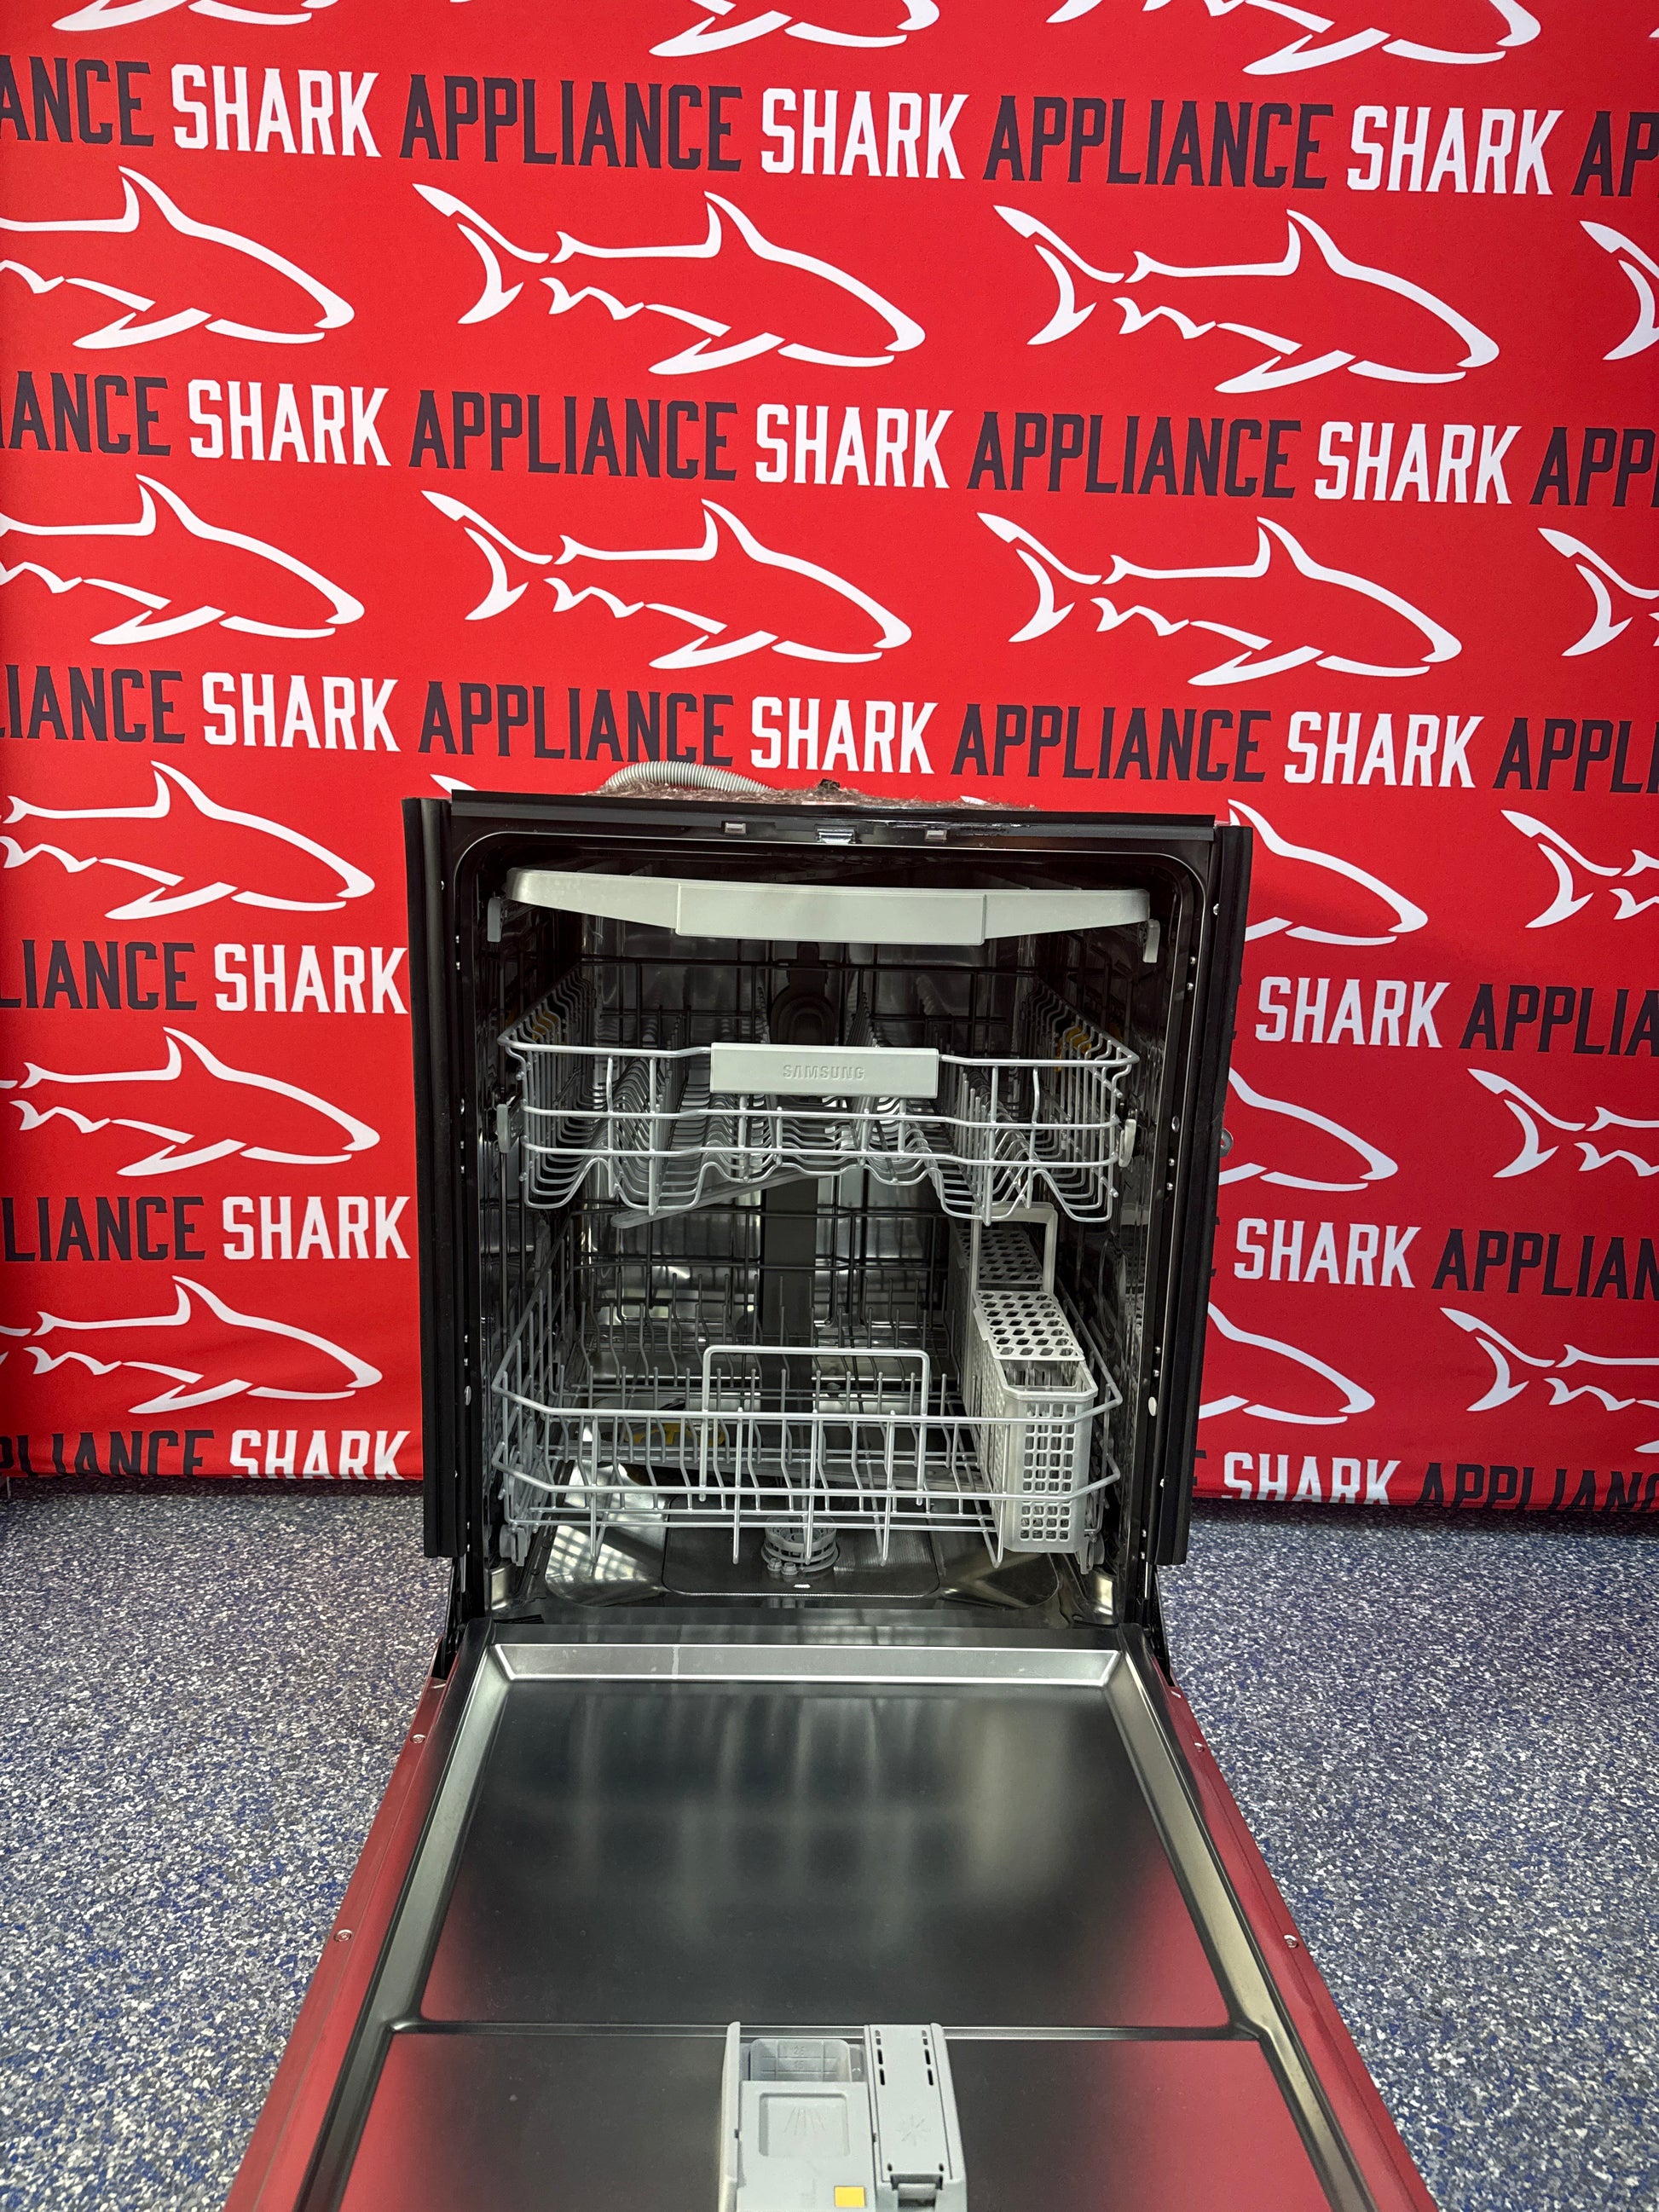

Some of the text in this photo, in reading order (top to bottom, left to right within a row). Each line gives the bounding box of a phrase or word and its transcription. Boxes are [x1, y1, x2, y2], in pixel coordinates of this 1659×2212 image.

[0, 55, 153, 147] ANCE
[171, 63, 382, 158] SHARK
[400, 74, 743, 170] APPLIANCE
[760, 87, 969, 180] SHARK
[983, 95, 1334, 189] APPLIANCE
[1346, 105, 1564, 195] SHARK
[0, 371, 1659, 508] ANCE SHARK APPLIANCE SHARK APPLIANCE SHARK APP
[0, 664, 186, 744] IANCE
[201, 671, 402, 752] SHARK
[419, 681, 733, 767] APPLIANCE
[750, 696, 939, 776] SHARK
[951, 703, 1271, 783] APPLIANCE
[1284, 711, 1485, 788] SHARK
[214, 943, 409, 1014] SHARK
[1255, 976, 1451, 1048] SHARK
[1460, 983, 1659, 1058] APPLIA
[783, 1064, 865, 1081] SAMSUNG
[2, 1195, 411, 1262] LIANCE SHARK
[1234, 1217, 1421, 1288] SHARK
[228, 1429, 411, 1481] SHARK
[1222, 1451, 1402, 1505] SHARK
